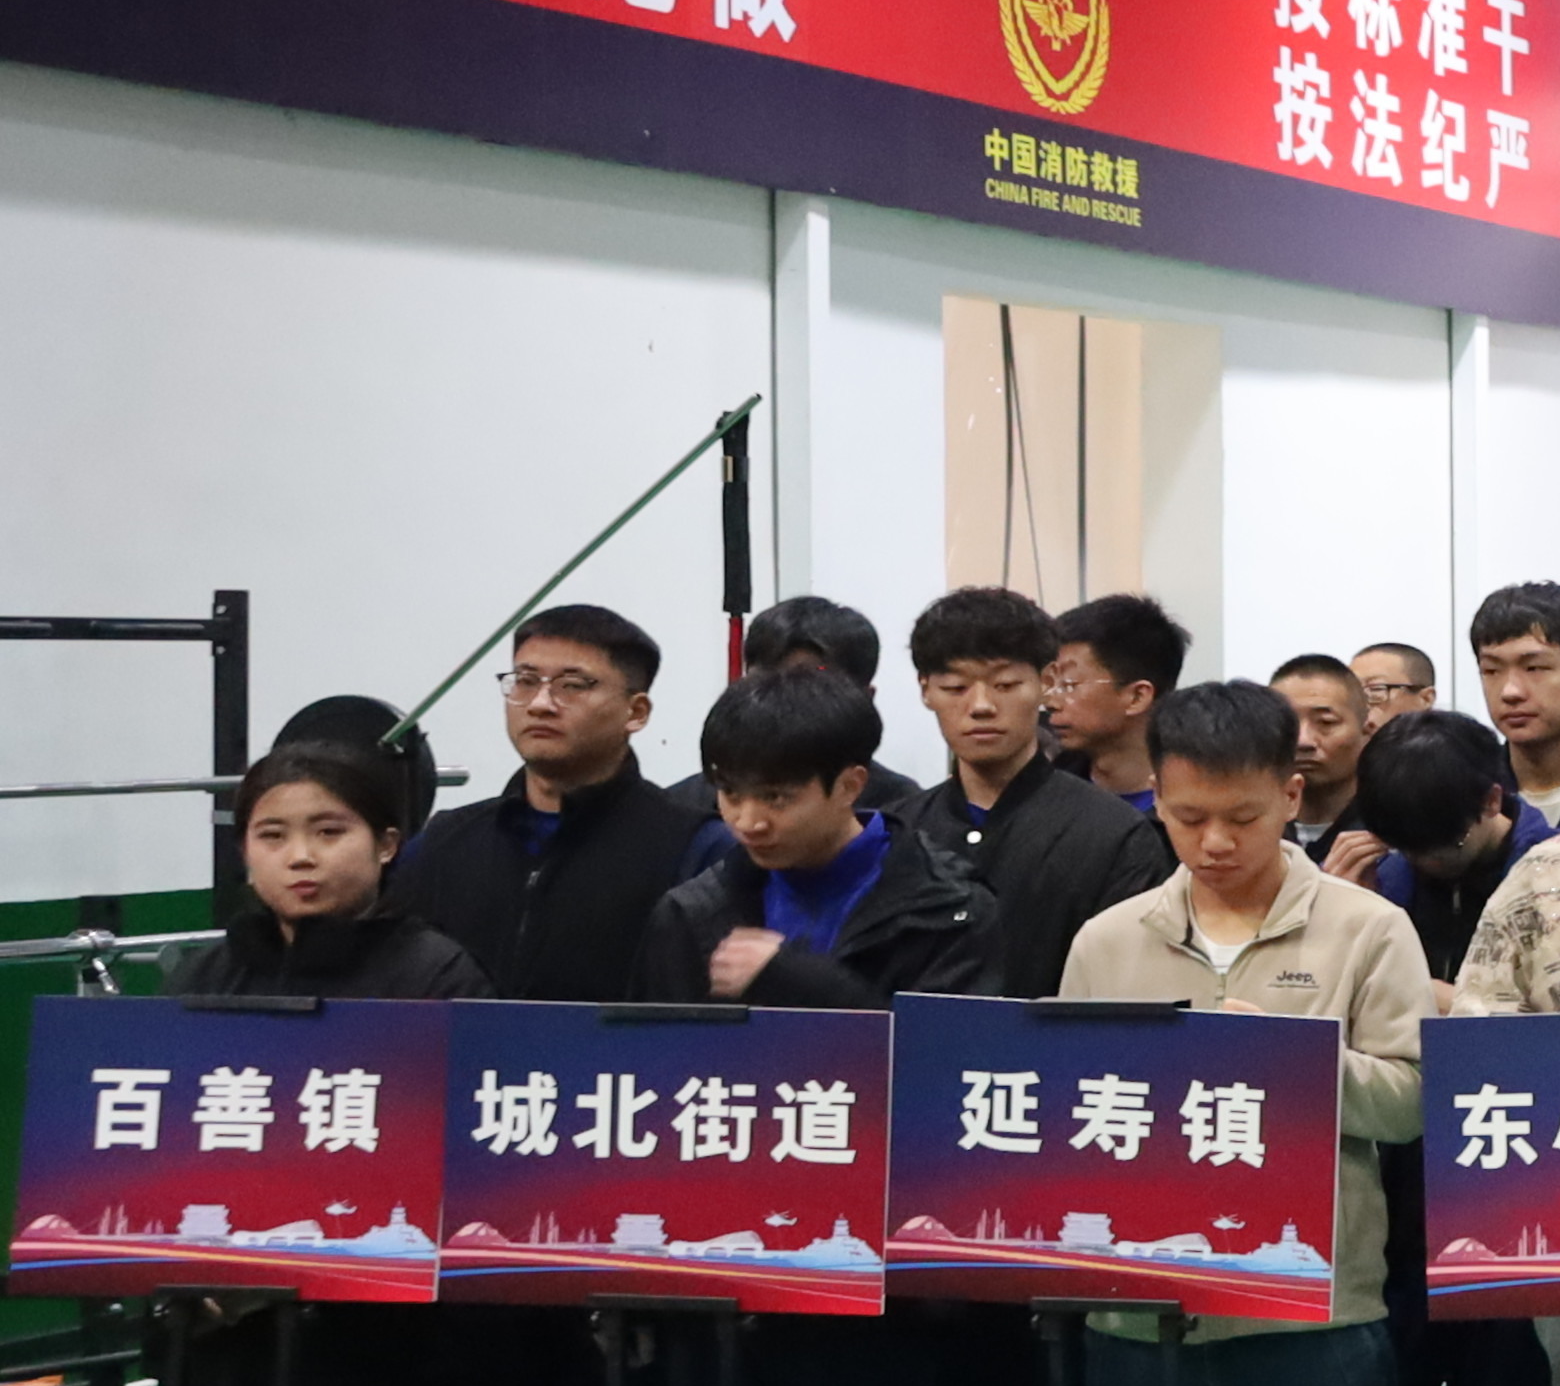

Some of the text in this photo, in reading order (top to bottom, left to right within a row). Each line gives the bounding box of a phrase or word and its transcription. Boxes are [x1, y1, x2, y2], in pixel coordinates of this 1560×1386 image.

[984, 127, 1139, 199] 中国消防救援
[1273, 46, 1531, 210] 按法纪严
[985, 178, 1142, 227] CHINA FIRE AND RESCUE
[1276, 970, 1313, 984] Jeep
[93, 1067, 380, 1152] 百善镇
[472, 1070, 855, 1163] 城北街道
[958, 1071, 1264, 1167] 延寿镇
